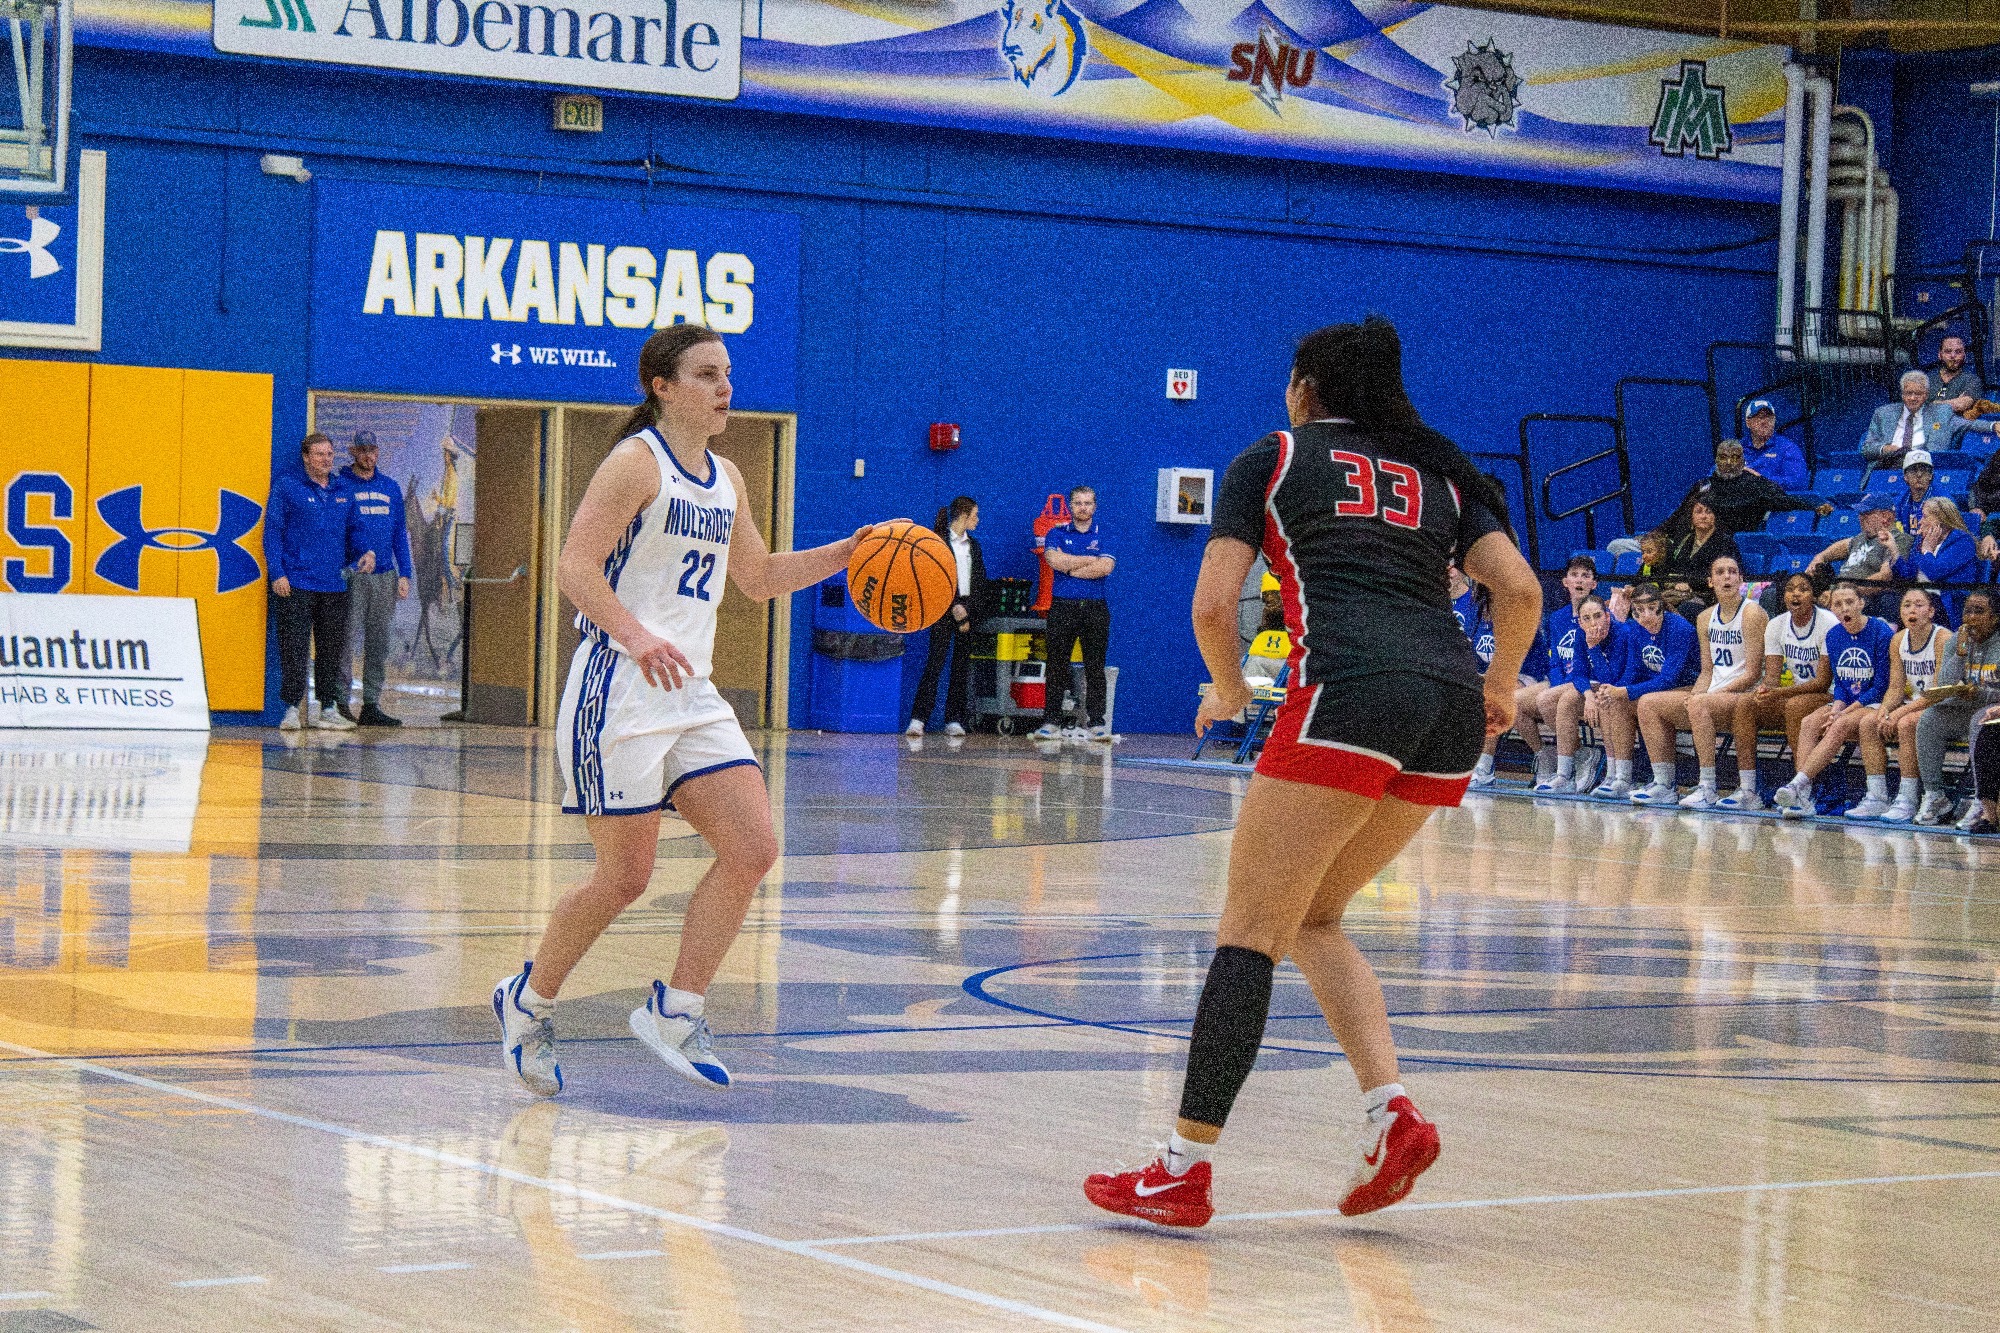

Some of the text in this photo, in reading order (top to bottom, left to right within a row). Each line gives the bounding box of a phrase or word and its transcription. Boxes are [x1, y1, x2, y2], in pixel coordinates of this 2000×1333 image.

[333, 0, 721, 72] Albemarle
[1227, 34, 1317, 91] SNU
[564, 101, 596, 127] EXIT
[362, 230, 755, 335] ARKANSAS
[529, 347, 617, 368] WE WILL.
[1174, 370, 1189, 379] AED
[1330, 449, 1423, 530] 33
[4, 470, 74, 594] S
[663, 497, 735, 546] MULERIDER
[677, 549, 716, 602] 22
[1714, 647, 1734, 667] 20
[55, 687, 71, 704] &
[77, 687, 175, 708] FITNESS
